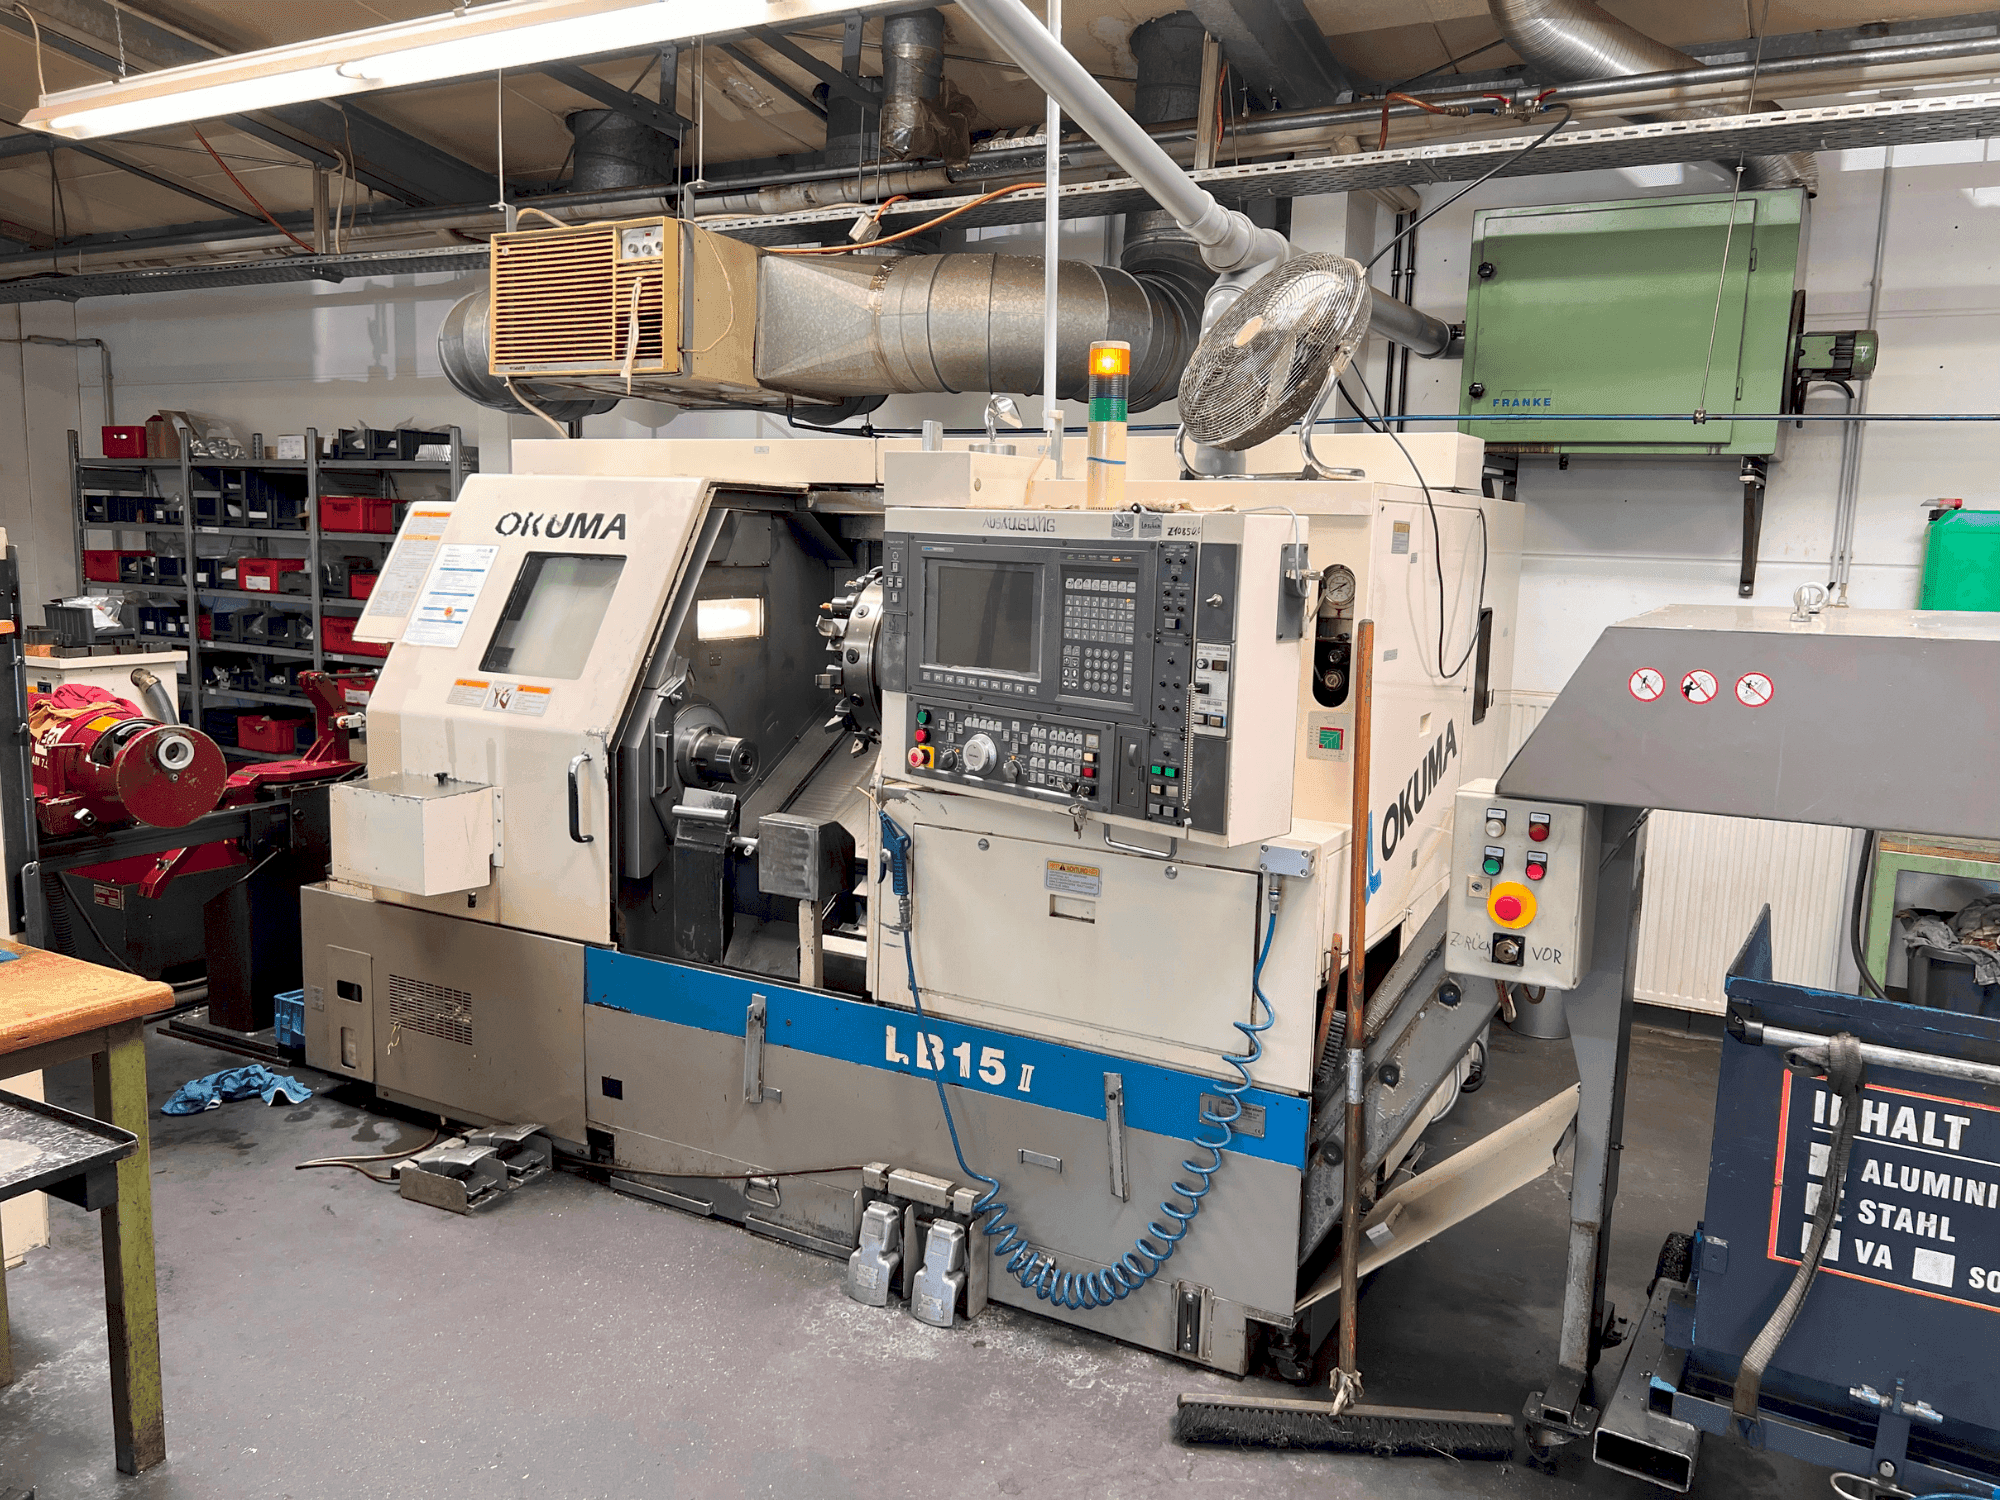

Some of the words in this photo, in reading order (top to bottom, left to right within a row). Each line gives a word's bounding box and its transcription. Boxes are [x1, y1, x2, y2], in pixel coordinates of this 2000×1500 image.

[1493, 398, 1551, 407] FRANKE
[495, 512, 626, 540] OKUMA
[1382, 718, 1457, 861] OKUMA
[1532, 946, 1561, 965] VOR
[1857, 1199, 1956, 1243] STAHL
[1854, 1238, 1893, 1271] VA
